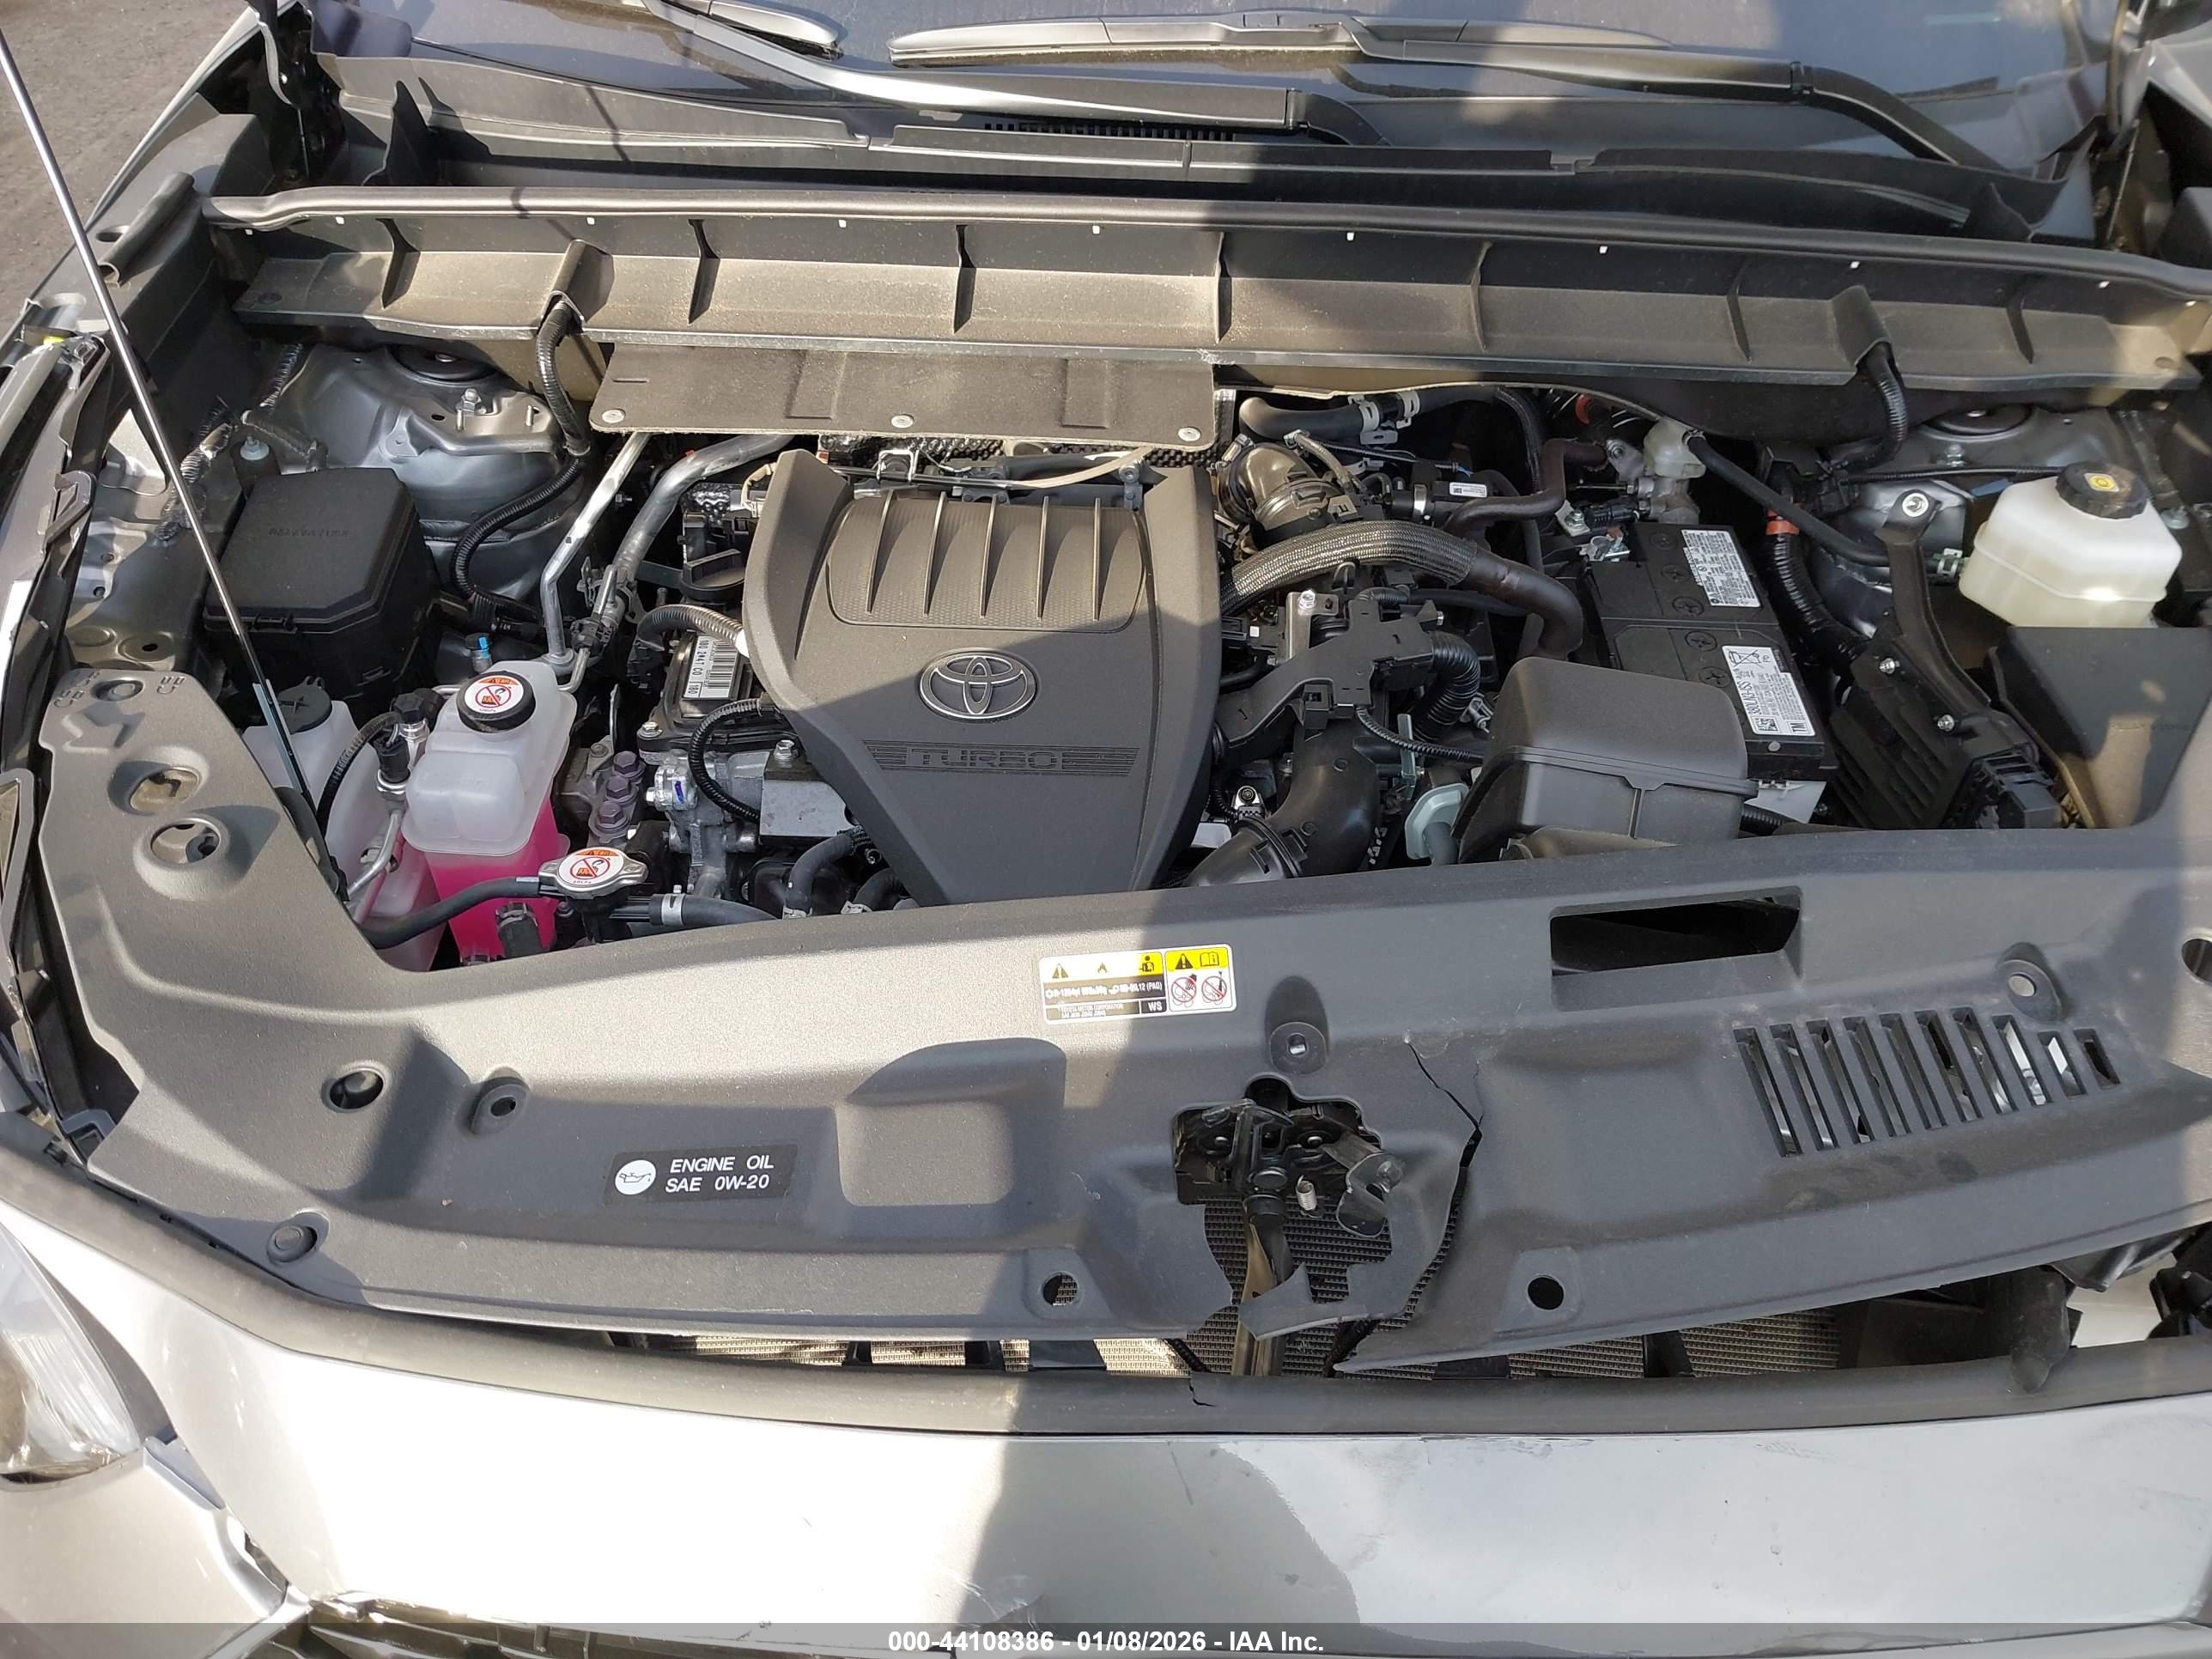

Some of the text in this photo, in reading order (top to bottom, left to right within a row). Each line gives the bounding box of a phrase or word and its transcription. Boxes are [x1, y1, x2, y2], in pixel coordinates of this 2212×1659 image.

[1790, 721, 1808, 732] TM
[910, 747, 1059, 769] TURBO
[1148, 1001, 1163, 1012] WS
[670, 1154, 774, 1174] ENGINE OIL
[665, 1174, 769, 1193] SAE 0W-20
